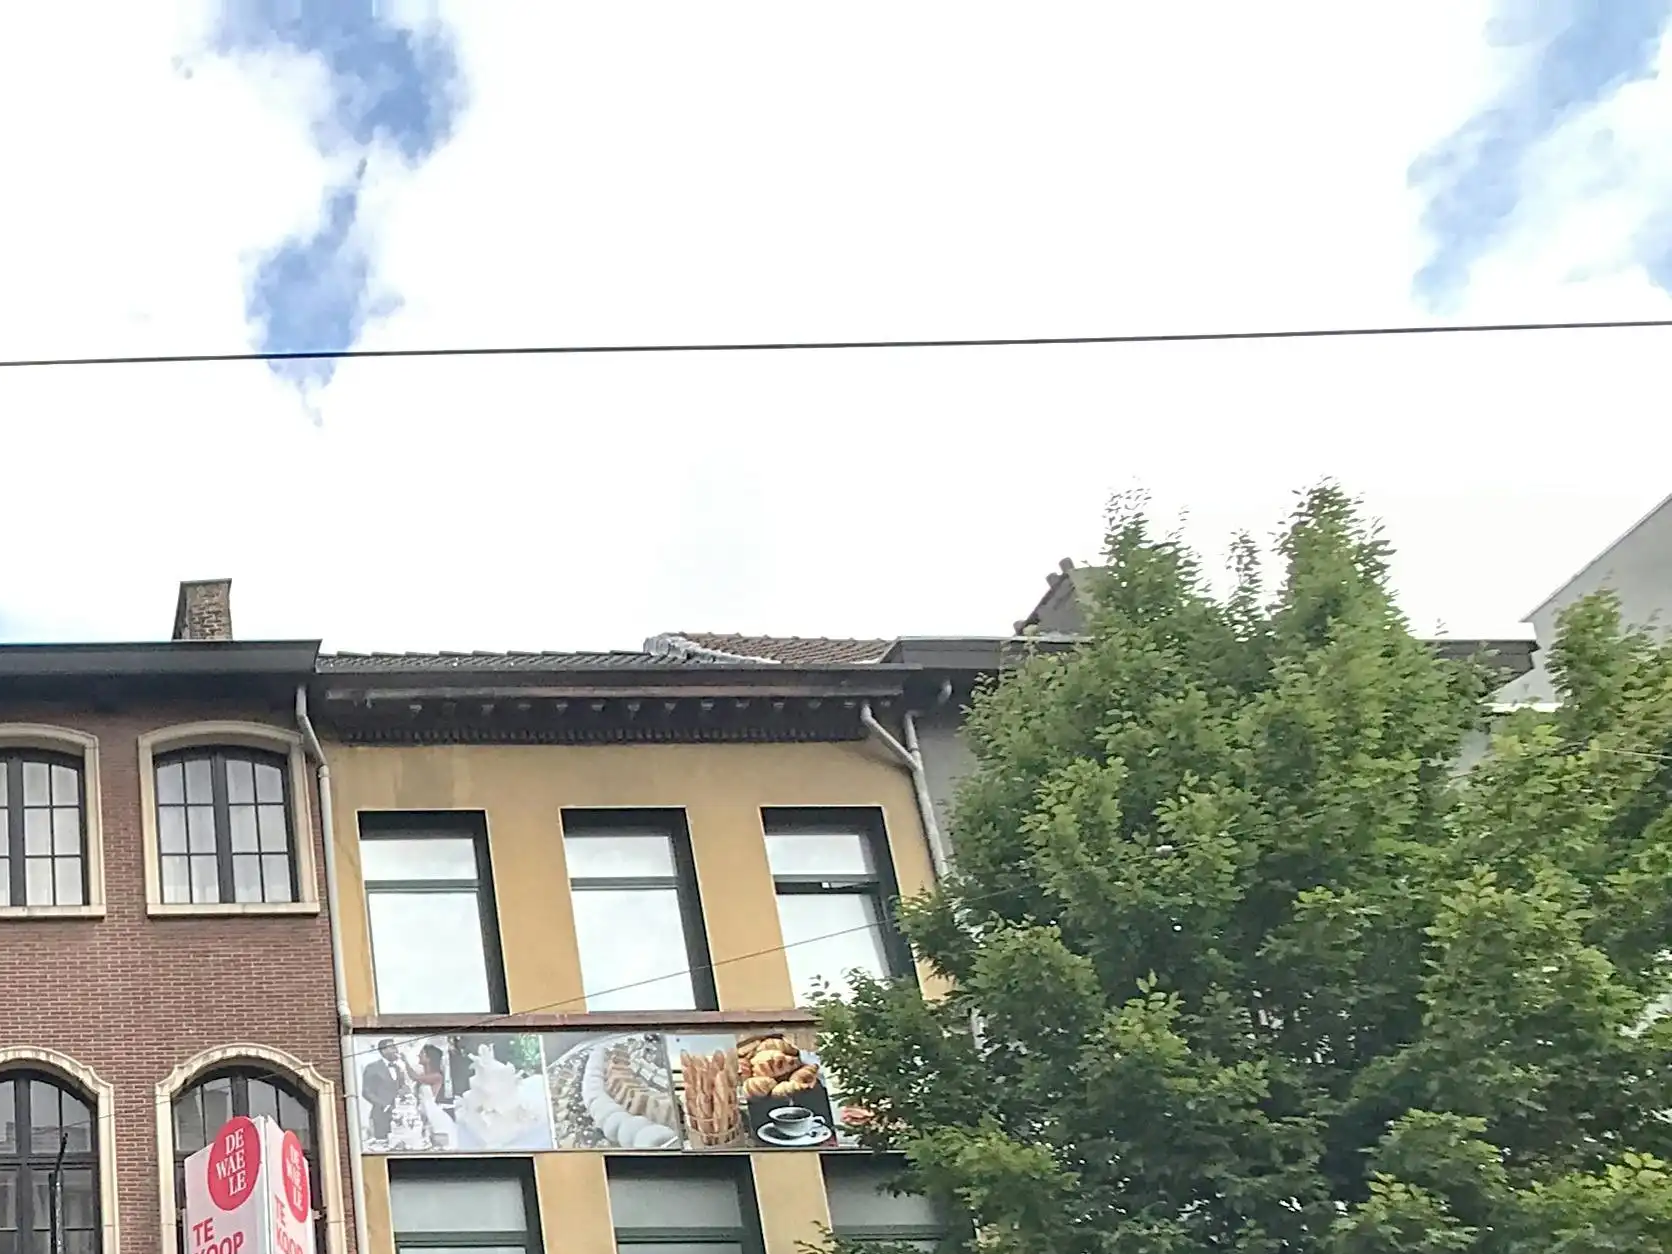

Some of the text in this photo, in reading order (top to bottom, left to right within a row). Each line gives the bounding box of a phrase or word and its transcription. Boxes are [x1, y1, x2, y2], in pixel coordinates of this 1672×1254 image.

[225, 1127, 245, 1155] DE
[215, 1148, 246, 1181] WAE
[228, 1170, 248, 1197] LE
[192, 1217, 215, 1248] TE
